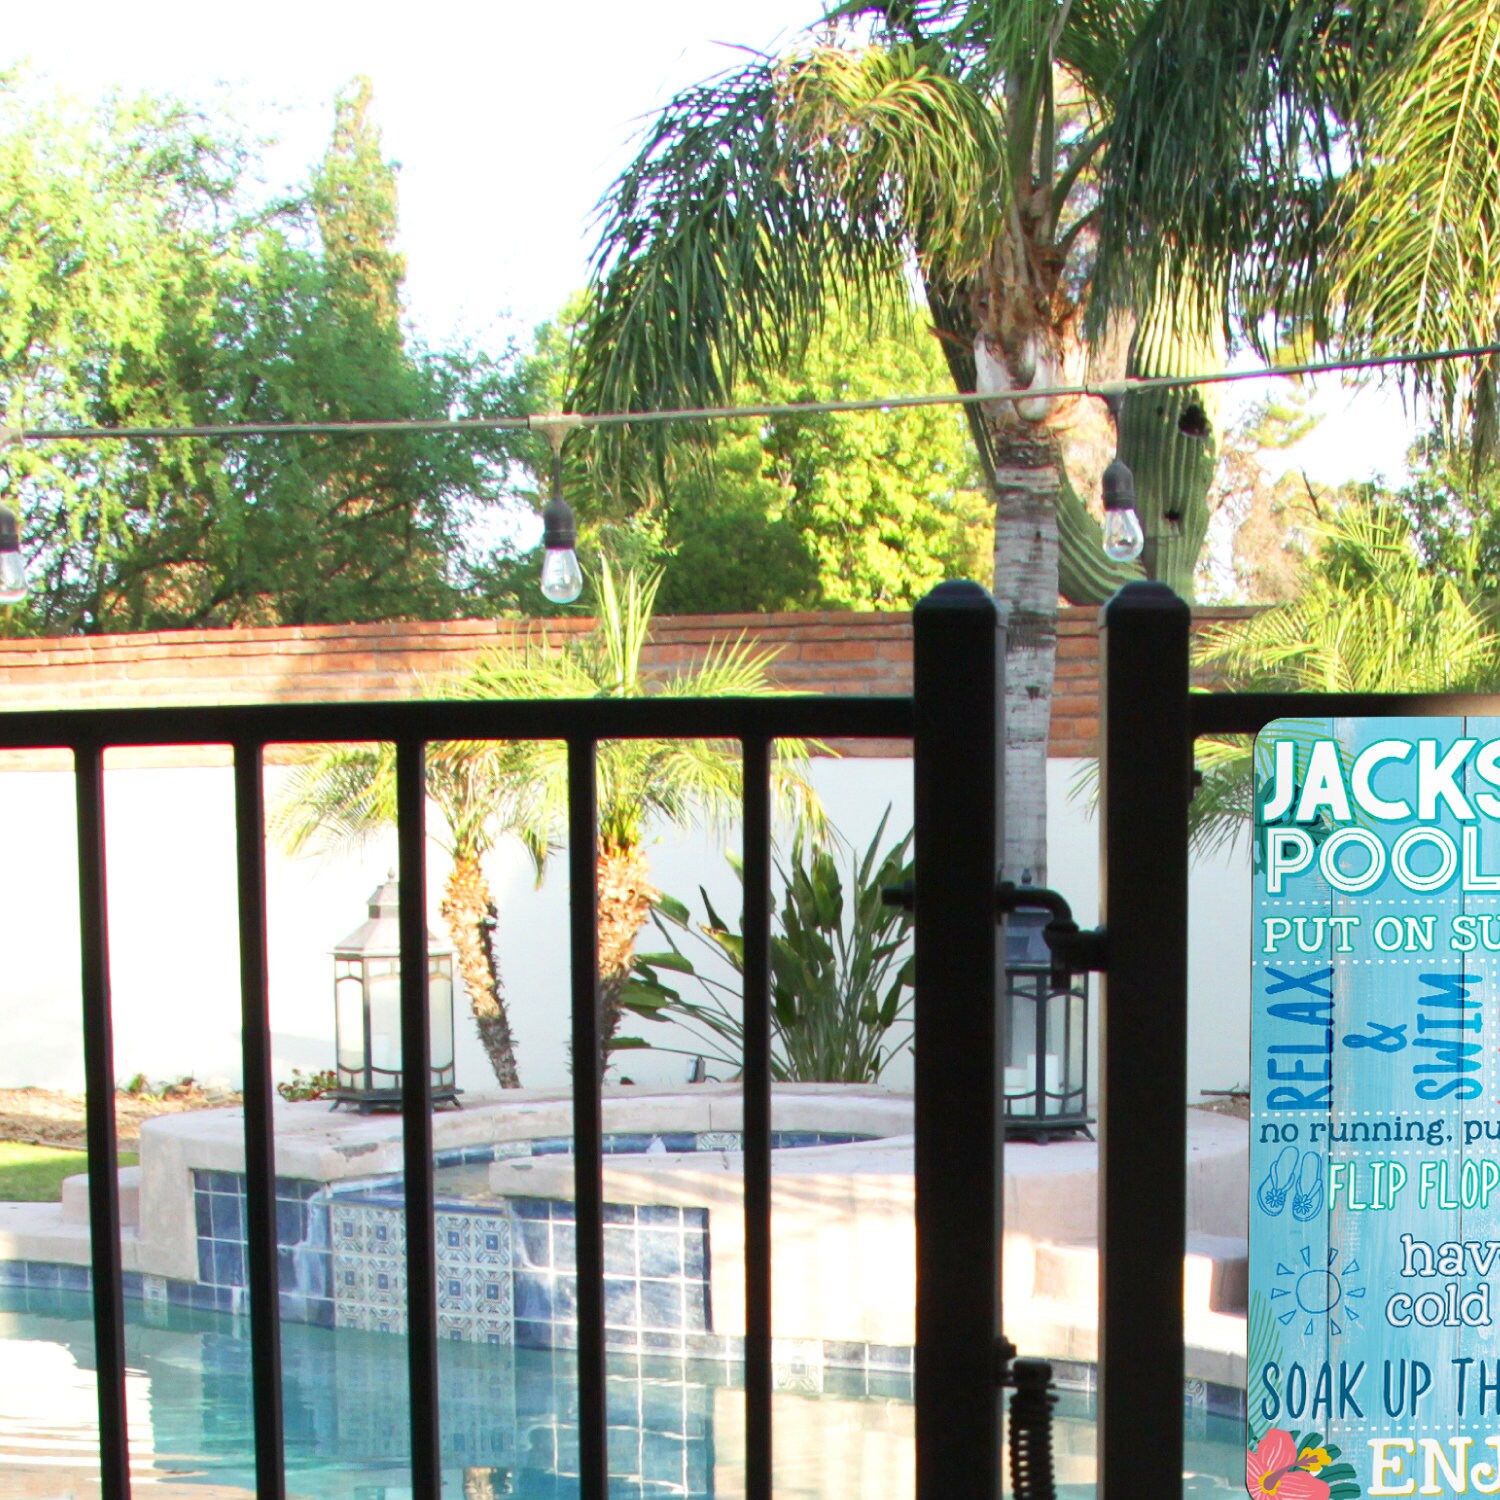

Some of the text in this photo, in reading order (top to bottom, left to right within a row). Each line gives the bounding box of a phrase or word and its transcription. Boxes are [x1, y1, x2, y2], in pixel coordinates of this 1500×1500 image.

[1262, 916, 1360, 954] PUT
[1373, 915, 1437, 952] ON
[1265, 966, 1335, 1111] RELAX
[1342, 1021, 1408, 1053] &
[1415, 973, 1483, 1101] SWIM
[1259, 1121, 1299, 1143] no
[1310, 1118, 1453, 1145] running,
[1328, 1162, 1407, 1211] FLIP
[1385, 1285, 1491, 1327] cold
[1261, 1360, 1365, 1422] SOAK
[1383, 1358, 1432, 1419] UP
